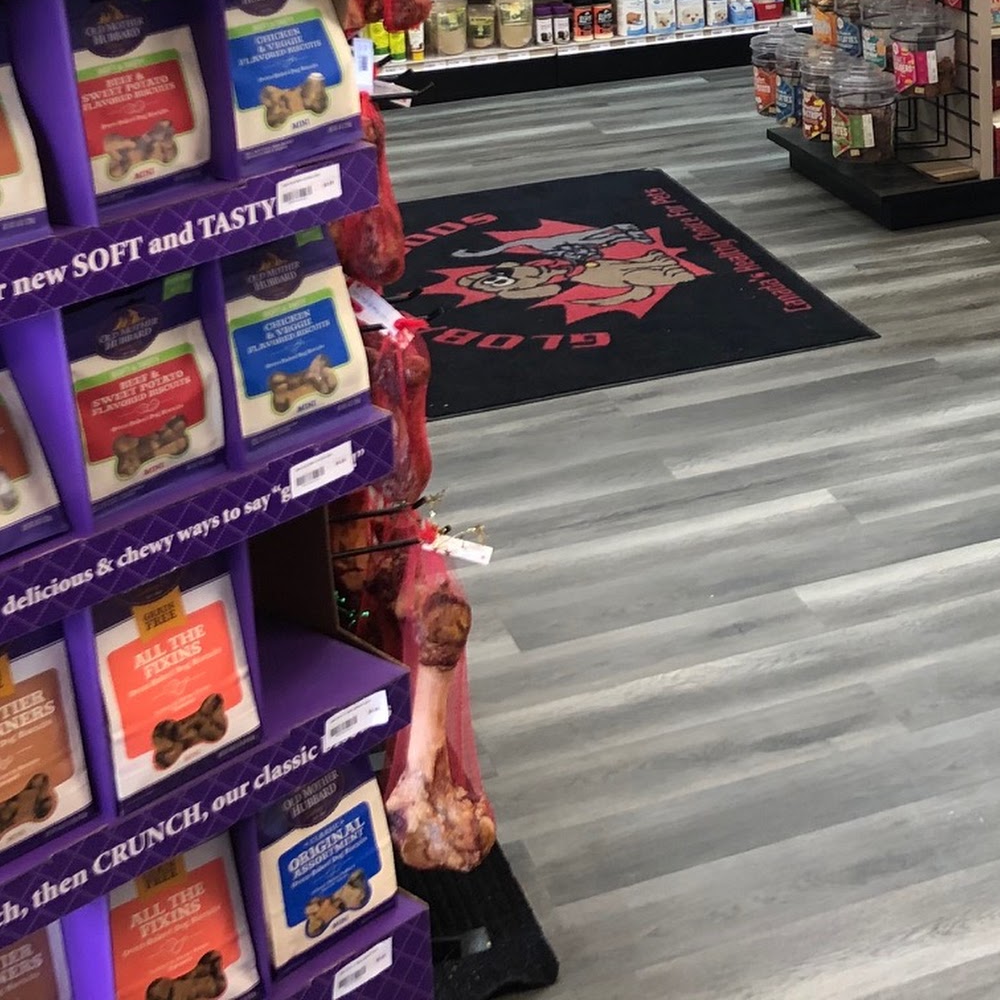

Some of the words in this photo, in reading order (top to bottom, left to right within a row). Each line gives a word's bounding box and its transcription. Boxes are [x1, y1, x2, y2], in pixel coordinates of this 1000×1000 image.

[238, 50, 287, 66] FLAVORED
[287, 40, 322, 56] BISCUITS
[255, 27, 301, 45] CHICKEN
[268, 35, 304, 51] VEGGIE
[81, 86, 124, 103] SWEET
[126, 75, 169, 93] POTATO
[105, 74, 134, 87] BEEF
[83, 93, 133, 111] FLAVORED
[12, 265, 69, 297] new
[71, 237, 144, 279] SOFT
[148, 221, 195, 255] and
[197, 197, 278, 240] TASTY
[247, 334, 297, 355] FLAVORED
[297, 320, 331, 340] BISCUITS
[263, 309, 311, 331] CHICKEN
[276, 318, 314, 338] VEGGIE
[91, 389, 137, 408] SWEET
[139, 370, 184, 394] POTATO
[91, 393, 147, 416] FLAVORED
[149, 376, 191, 397] BISCUITS
[119, 374, 149, 391] BEEF
[1, 567, 94, 616] delicious
[96, 558, 115, 577] &
[116, 532, 174, 568] chewy
[177, 514, 220, 543] ways
[223, 504, 241, 524] to
[244, 491, 271, 515] say
[143, 602, 175, 621] GRAIN
[145, 611, 178, 631] FREE
[133, 645, 169, 670] ALL
[168, 624, 207, 647] THE
[143, 641, 203, 679] FIXINS
[291, 783, 337, 820] HUBBARD
[32, 871, 88, 909] then
[92, 802, 209, 876] CRUNCH,
[212, 785, 249, 810] our
[253, 744, 319, 790] classic
[288, 817, 365, 872] ORIGINAL
[293, 828, 364, 879] ASSORTMENT
[130, 906, 166, 929] ALL
[167, 882, 205, 907] THE
[139, 899, 201, 938] FIXINS
